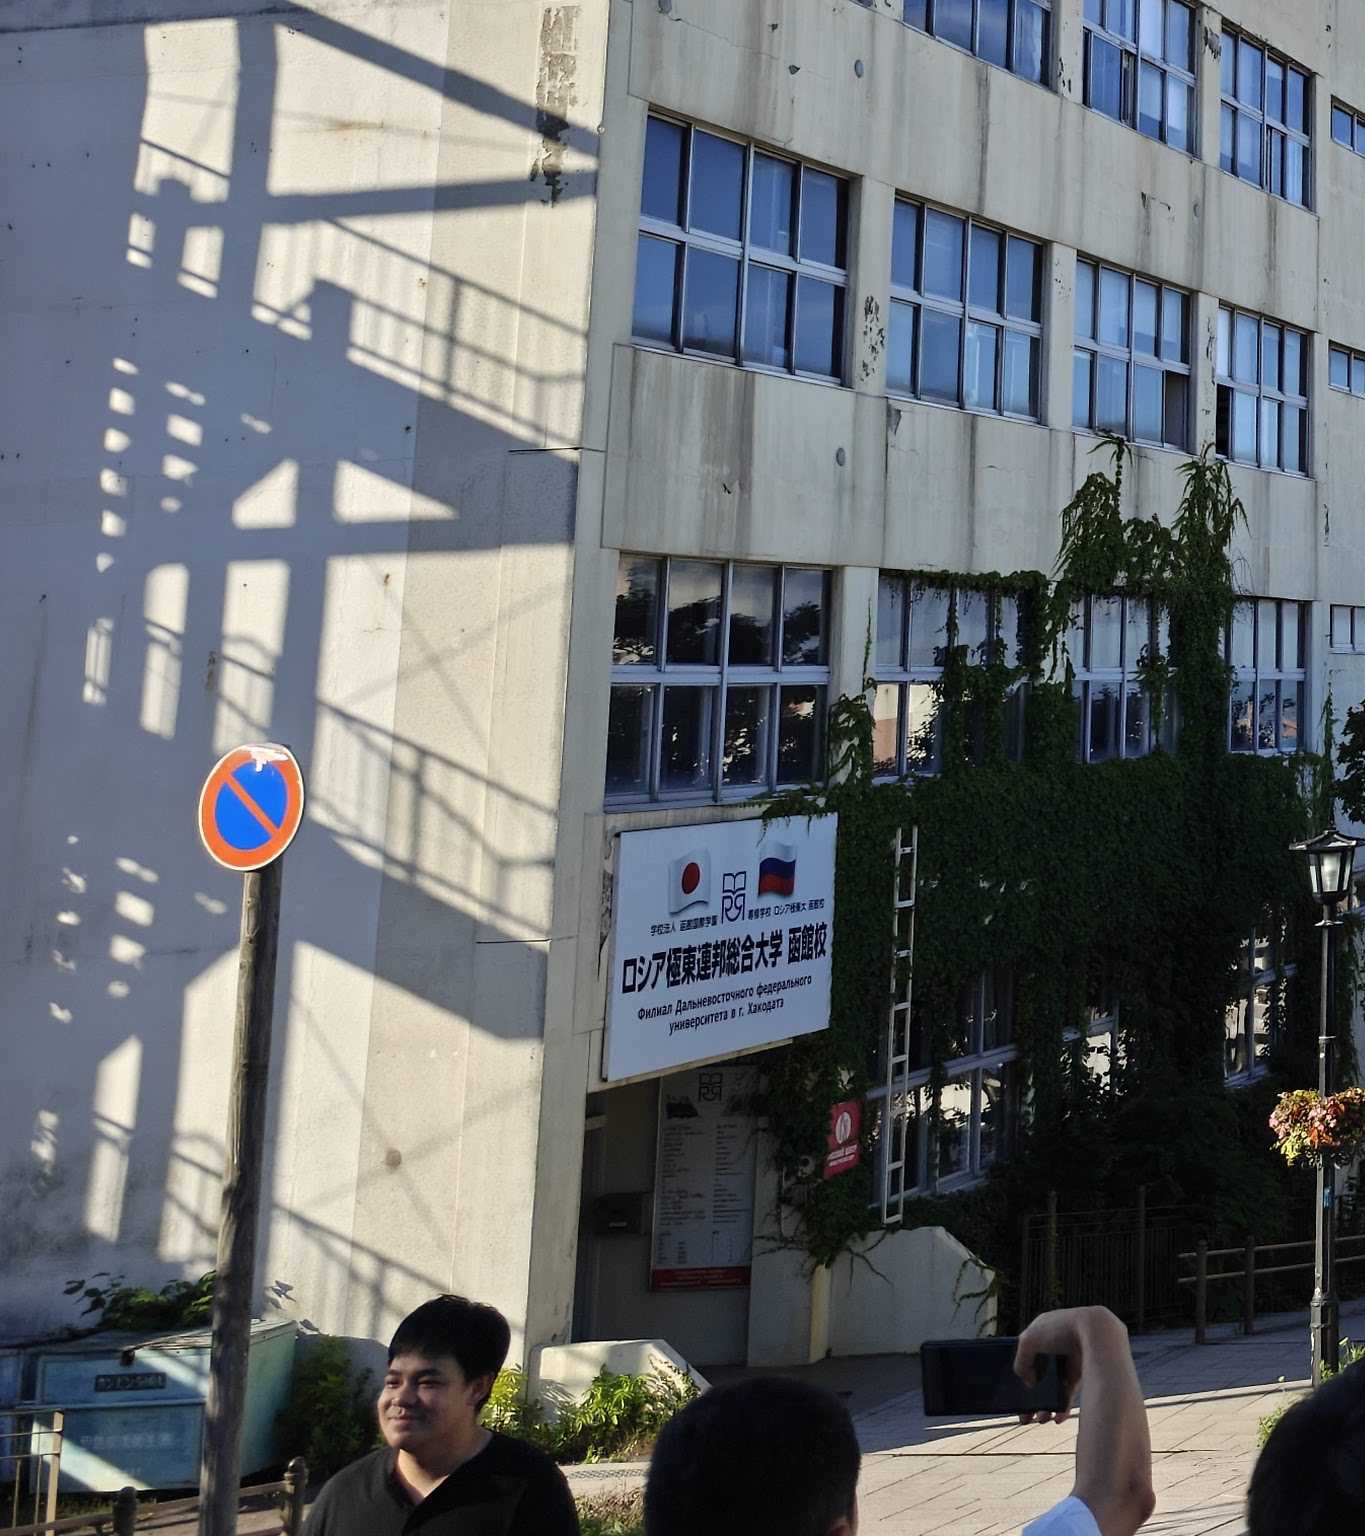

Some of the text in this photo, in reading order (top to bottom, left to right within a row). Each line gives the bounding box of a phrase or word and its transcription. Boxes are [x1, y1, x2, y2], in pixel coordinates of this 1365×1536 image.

[621, 921, 828, 994] ロシア極東連邦総合大学 函館校
[637, 974, 812, 1021] Филиал Дальневосточного федерального
[669, 1010, 728, 1037] университета
[730, 1008, 736, 1020] в
[738, 1006, 744, 1018] г.
